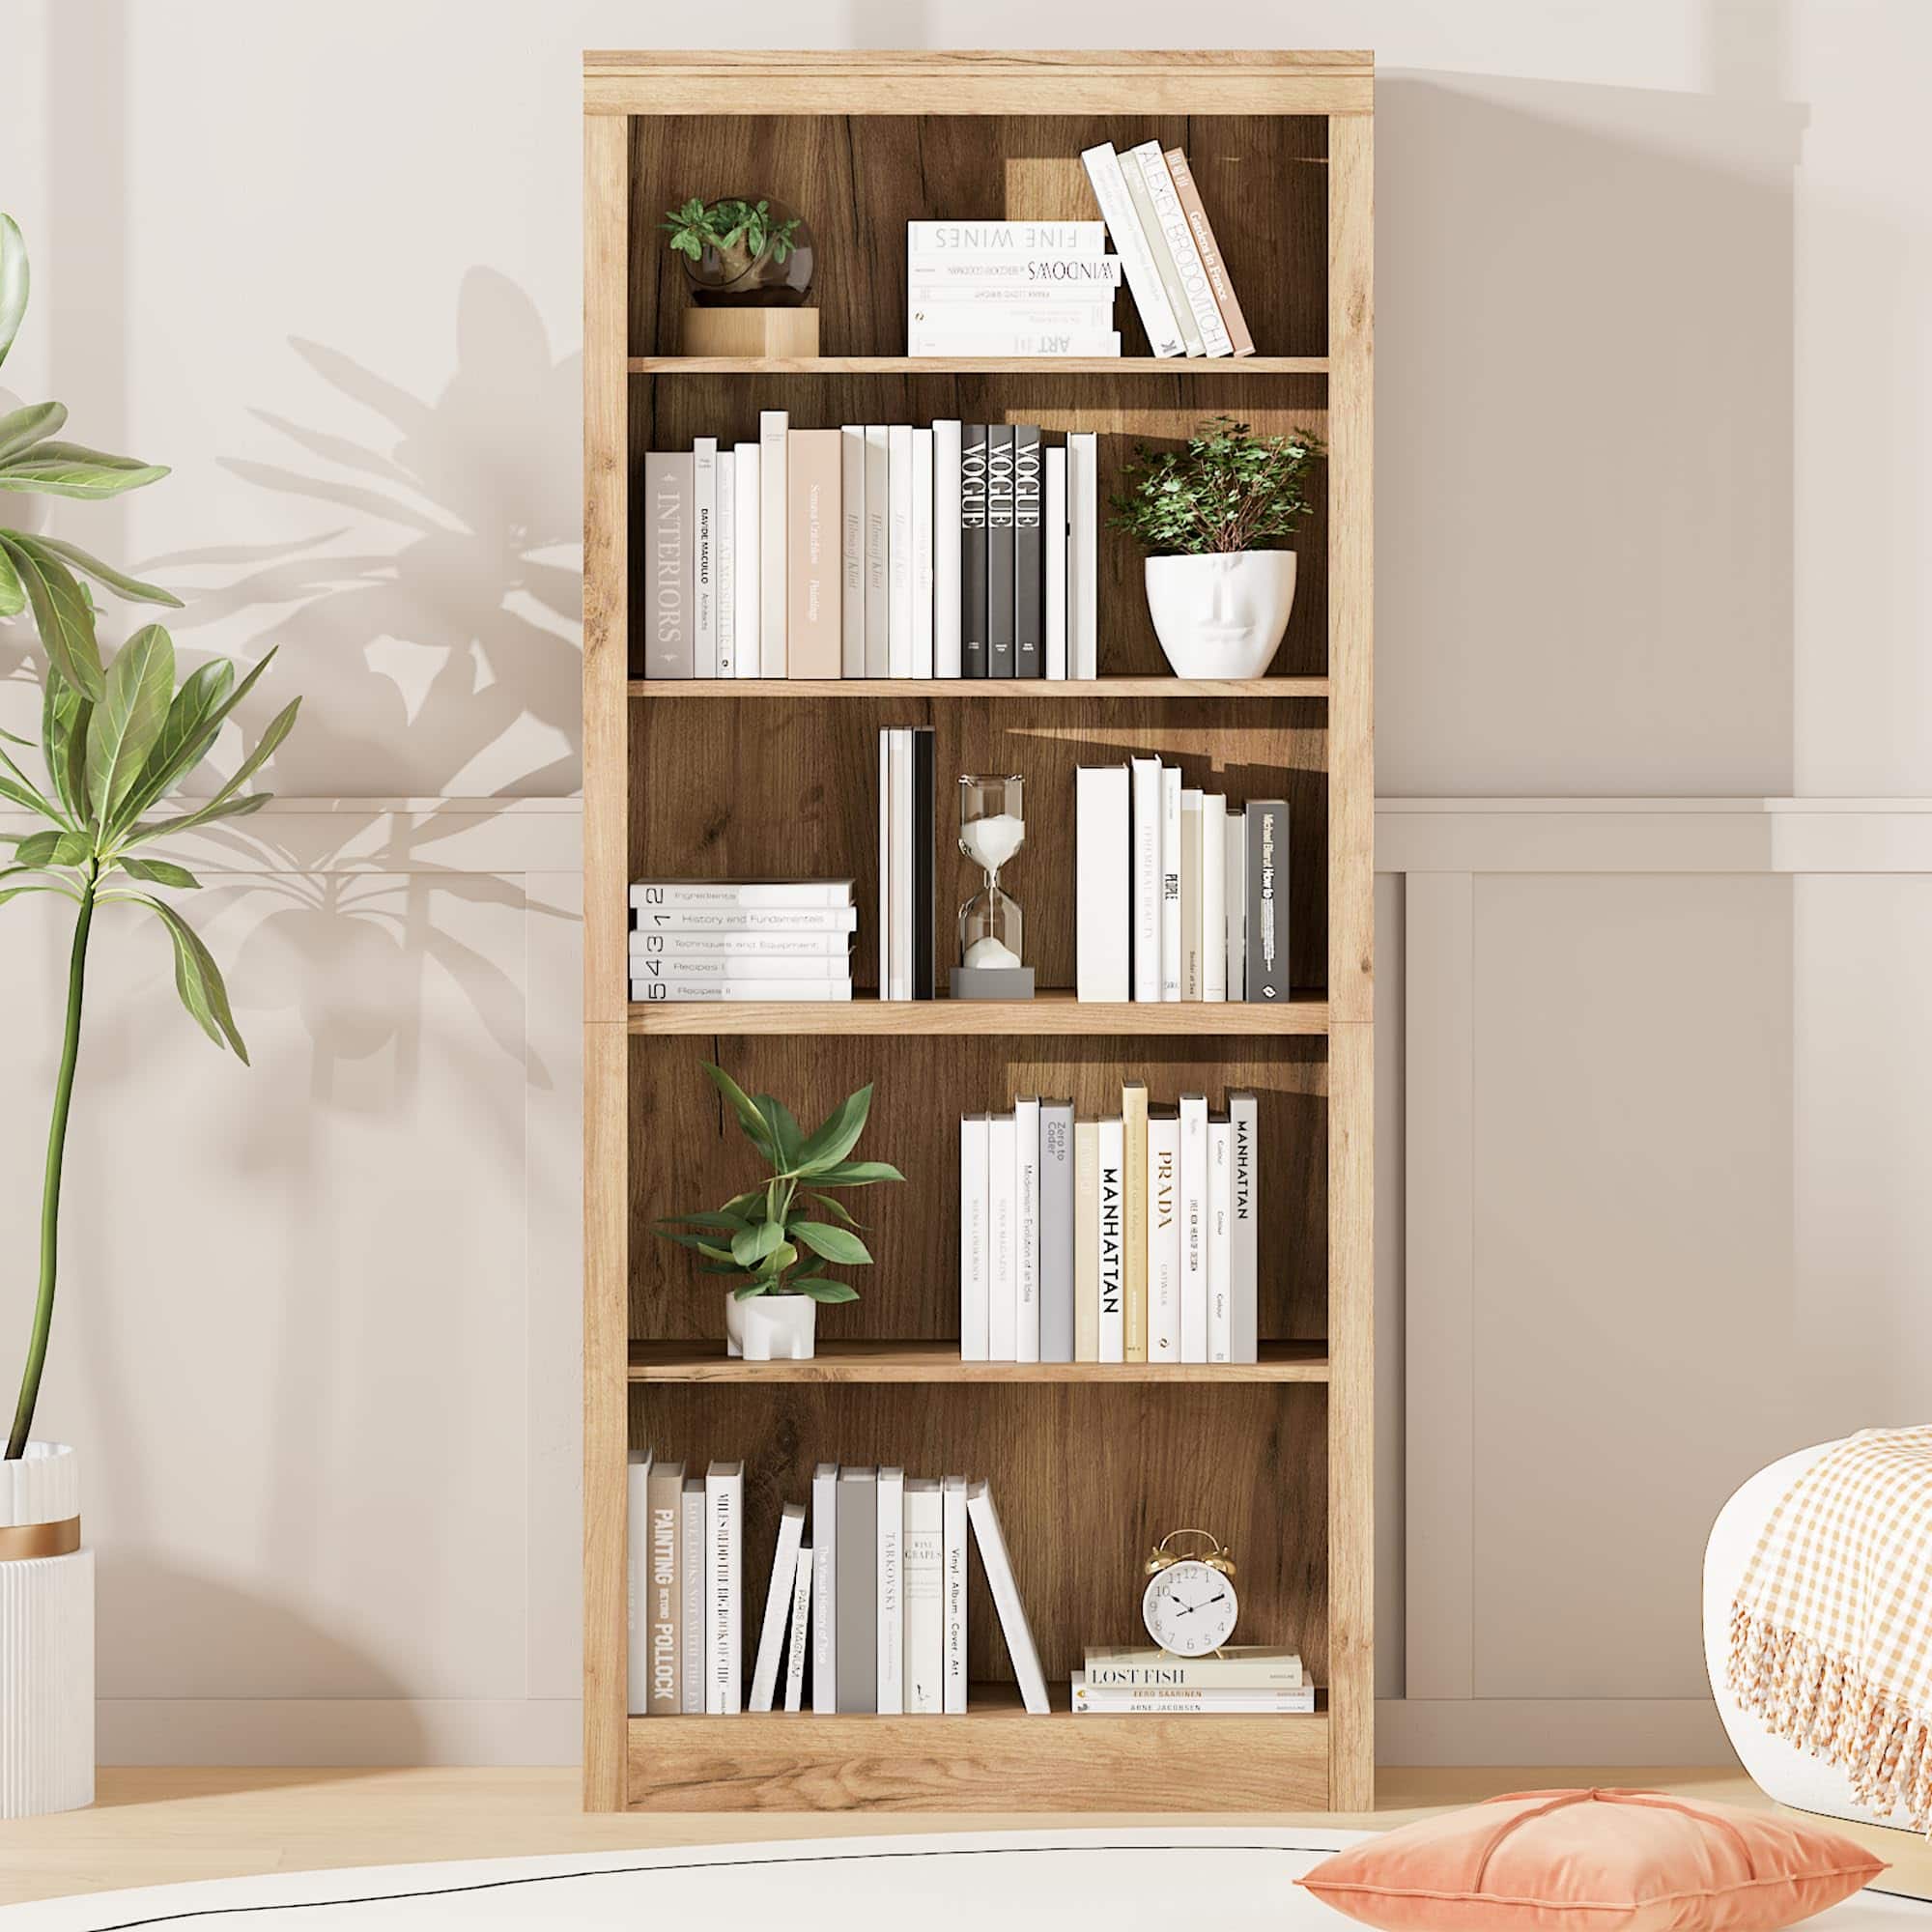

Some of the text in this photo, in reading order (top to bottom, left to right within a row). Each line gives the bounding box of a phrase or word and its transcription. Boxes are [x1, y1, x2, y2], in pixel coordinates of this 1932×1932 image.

[936, 228, 1077, 247] FINE WINES
[1138, 152, 1179, 218] ALEXEY
[1167, 222, 1224, 345] BRODOVITCH
[1028, 261, 1114, 280] WINDOWS
[962, 440, 985, 528] VOGUE
[988, 440, 1012, 528] VOGUE
[1015, 440, 1040, 528] VOGUE
[658, 493, 680, 642] INTERIORS
[1263, 814, 1274, 842] Michael
[1165, 873, 1179, 900] PEOPLE
[1263, 868, 1274, 888] How
[645, 888, 664, 904] 2
[1263, 889, 1274, 898] to
[654, 914, 824, 925] 1 History and Fundamentals
[646, 935, 664, 952] 3
[645, 959, 663, 977] 4
[673, 963, 718, 972] Recipes
[648, 982, 667, 1000] 5
[1047, 1121, 1056, 1154] Coder
[1057, 1122, 1065, 1161] Zero to
[1237, 1122, 1248, 1219] MANHATTAN
[1158, 1151, 1172, 1229] PRADA
[1103, 1169, 1119, 1313] MANHATTAN
[654, 1509, 673, 1585] PAINTING
[886, 1532, 896, 1611] TARKOVSKY
[1168, 1573, 1182, 1583] 11
[1183, 1568, 1198, 1579] 12
[1205, 1572, 1209, 1582] 1
[1156, 1585, 1171, 1597] 10
[796, 1589, 807, 1620] PARIS
[951, 1548, 960, 1676] Vinyl Album Cover Art
[1151, 1601, 1158, 1612] 9
[1225, 1603, 1232, 1613] 3
[1155, 1620, 1163, 1632] 8
[1218, 1622, 1225, 1633] 4
[1167, 1633, 1176, 1644] 7
[1187, 1638, 1195, 1650] 6
[1205, 1634, 1211, 1646] 5
[654, 1624, 673, 1699] POLLOCK
[1092, 1668, 1185, 1684] LOST FISH
